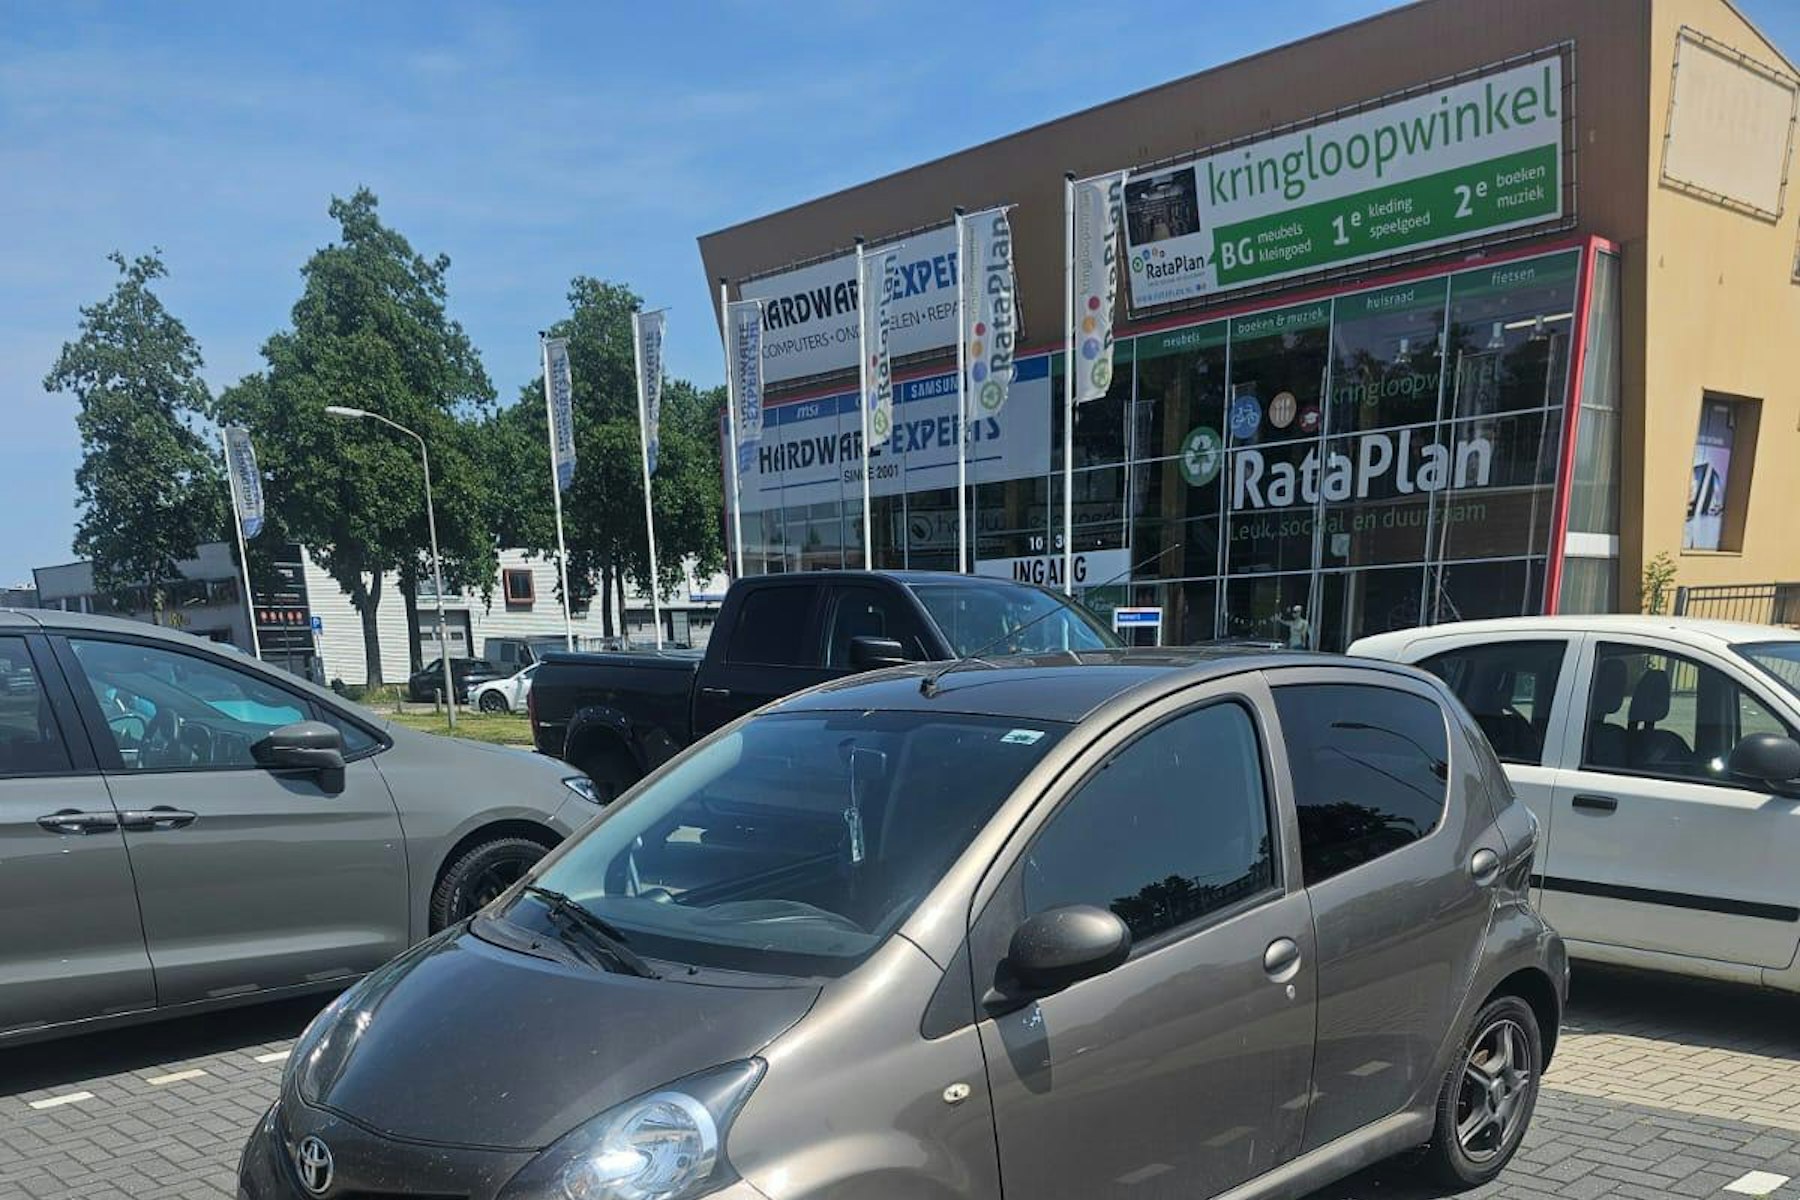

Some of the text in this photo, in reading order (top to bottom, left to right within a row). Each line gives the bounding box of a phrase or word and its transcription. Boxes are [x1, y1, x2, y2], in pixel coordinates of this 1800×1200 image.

[1208, 66, 1558, 206] kringloopwinkel
[1496, 165, 1545, 189] boeken
[1368, 198, 1413, 219] kleding
[1497, 184, 1545, 209] muziek
[1257, 222, 1303, 244] meubels
[1369, 211, 1431, 240] speelgoed
[1221, 237, 1254, 270] BG
[1259, 238, 1312, 262] kleingoed
[1146, 254, 1204, 279] RataPlan
[986, 217, 1012, 373] RataPlan
[1365, 289, 1415, 310] huisraad
[761, 330, 830, 359] COMPUTERS
[910, 379, 959, 400] SAMSUN
[877, 464, 899, 479] 2001
[1233, 430, 1491, 510] RataPlan
[1353, 512, 1377, 531] en
[1029, 536, 1044, 550] 10
